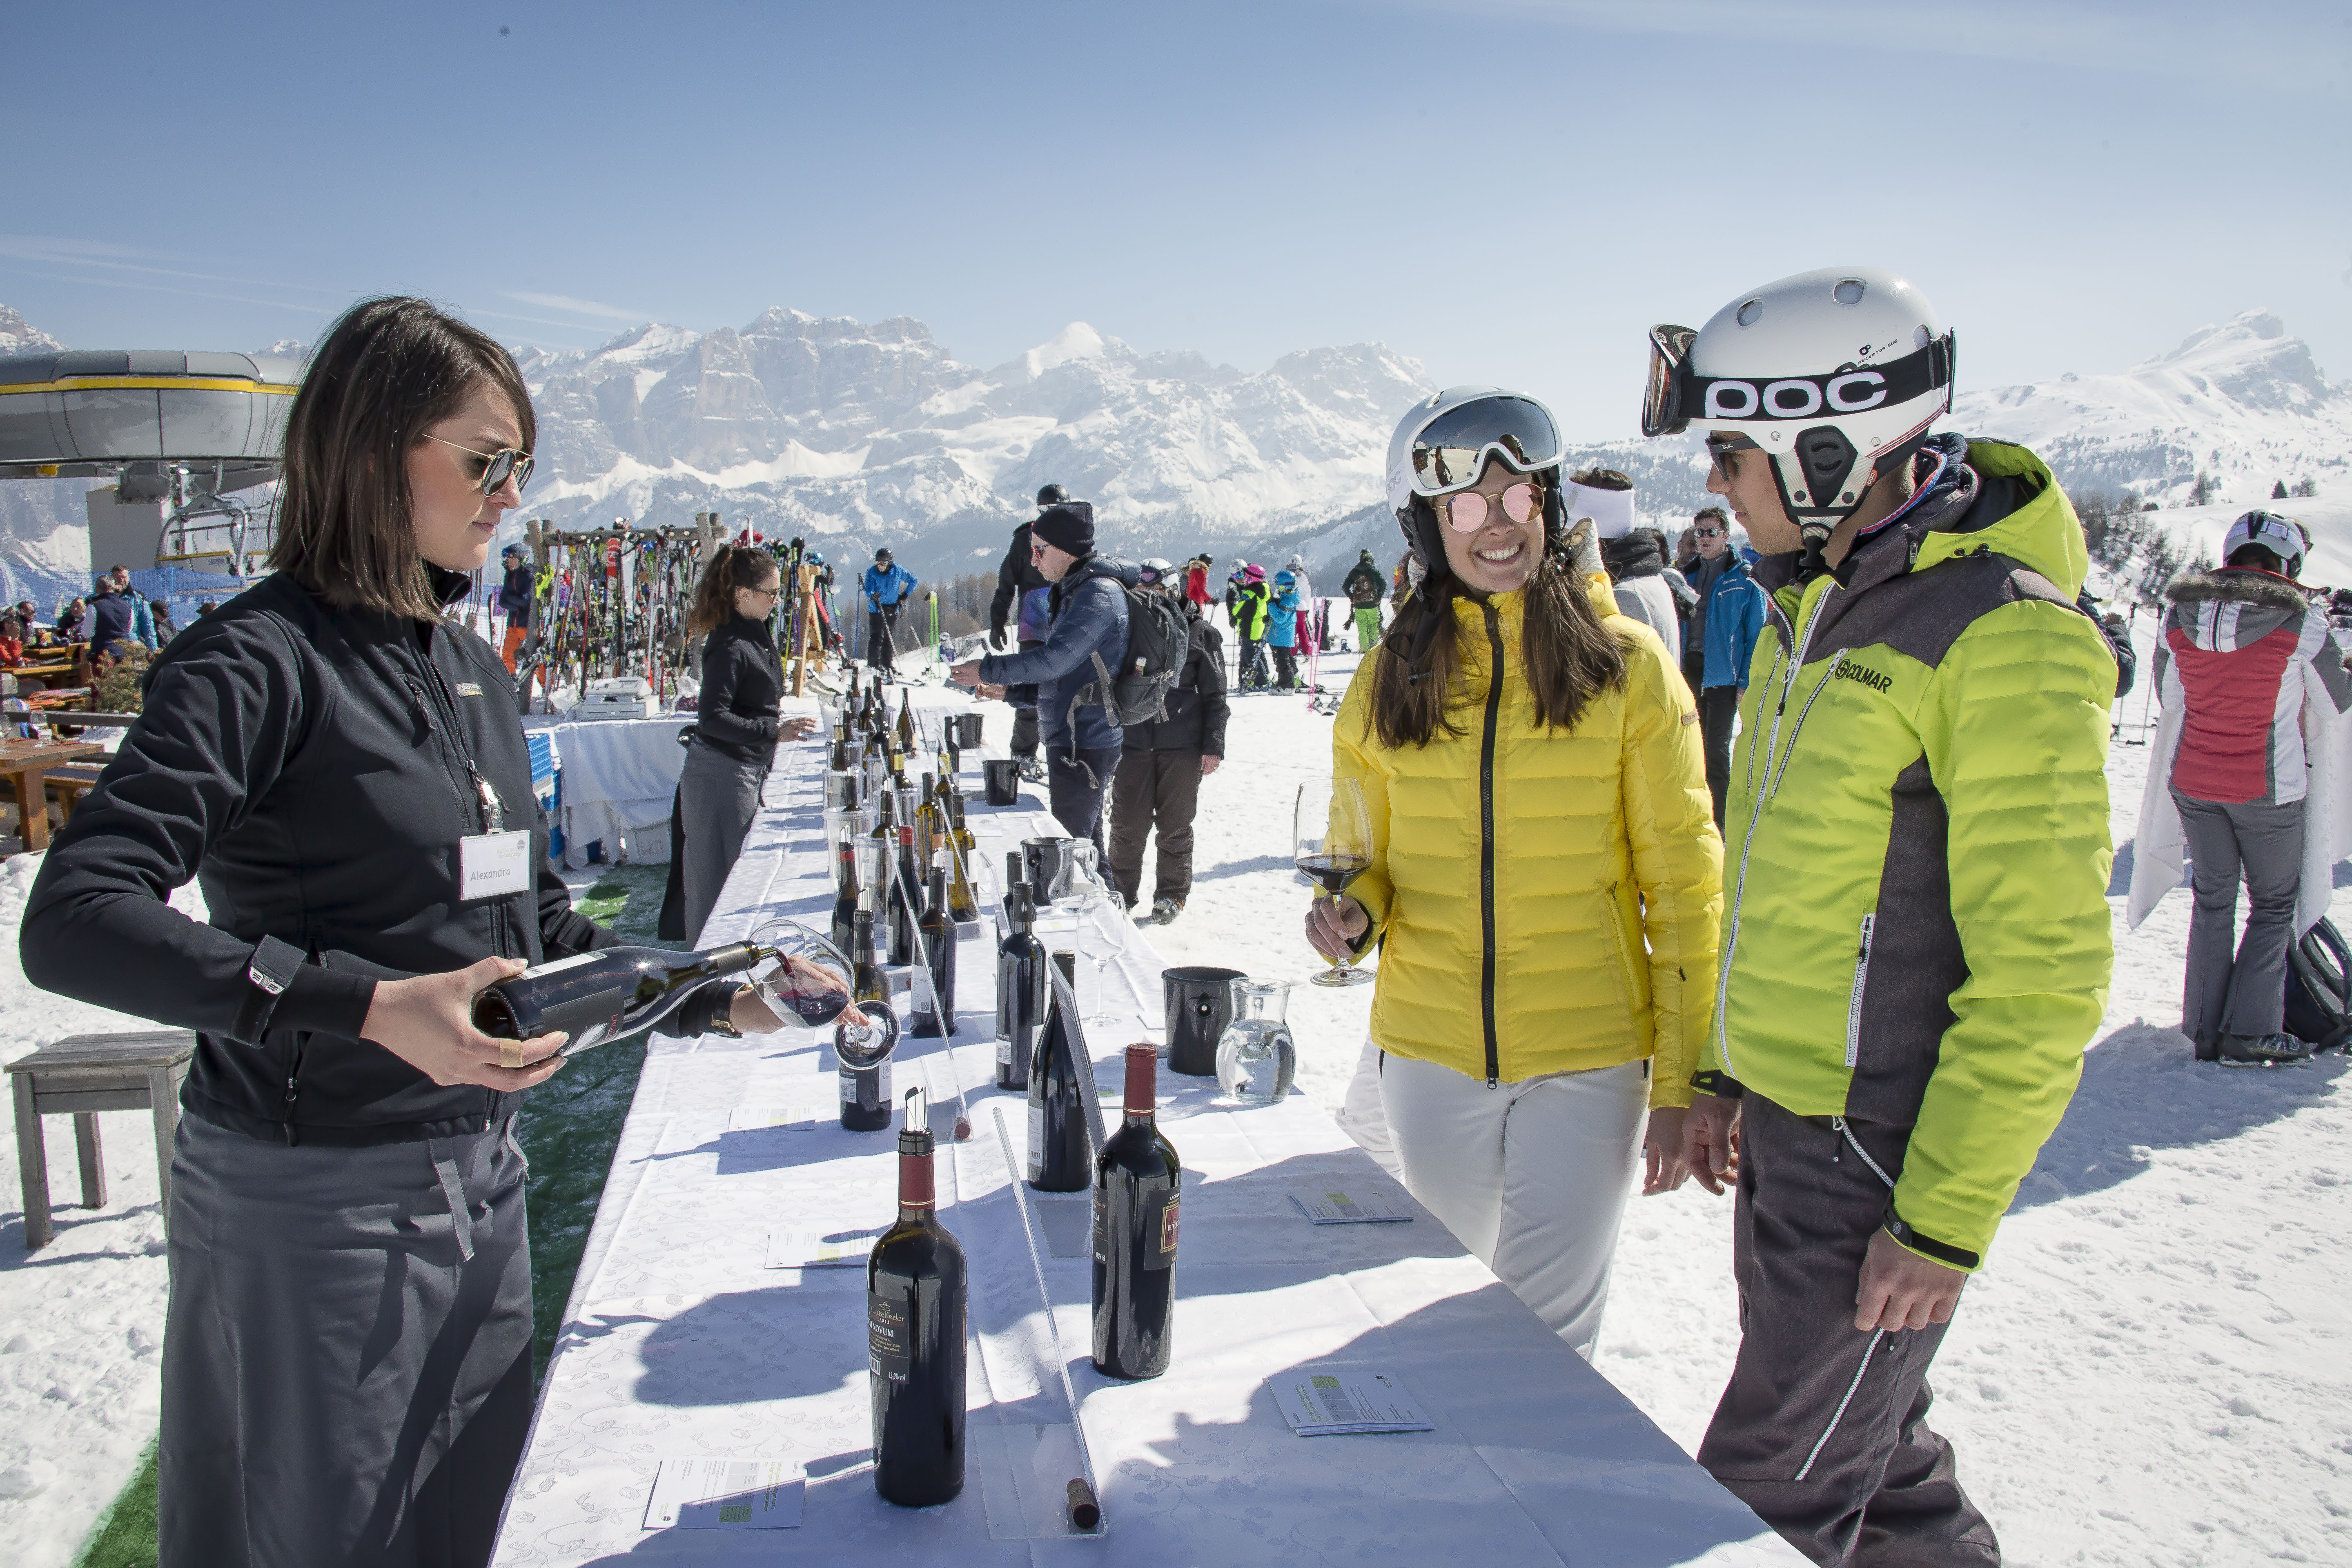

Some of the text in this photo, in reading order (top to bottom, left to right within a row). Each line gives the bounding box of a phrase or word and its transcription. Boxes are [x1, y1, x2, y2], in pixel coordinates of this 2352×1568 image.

[1858, 339, 1898, 365] RECEPTOR BUG
[1704, 372, 1886, 419] POC
[1867, 472, 1875, 485] POC
[1846, 664, 1892, 694] COLMAR
[470, 868, 510, 881] Alexandra
[871, 1306, 905, 1321] Castelfeder
[873, 1322, 894, 1338] NOVUM
[889, 1372, 899, 1381] 13,5%
